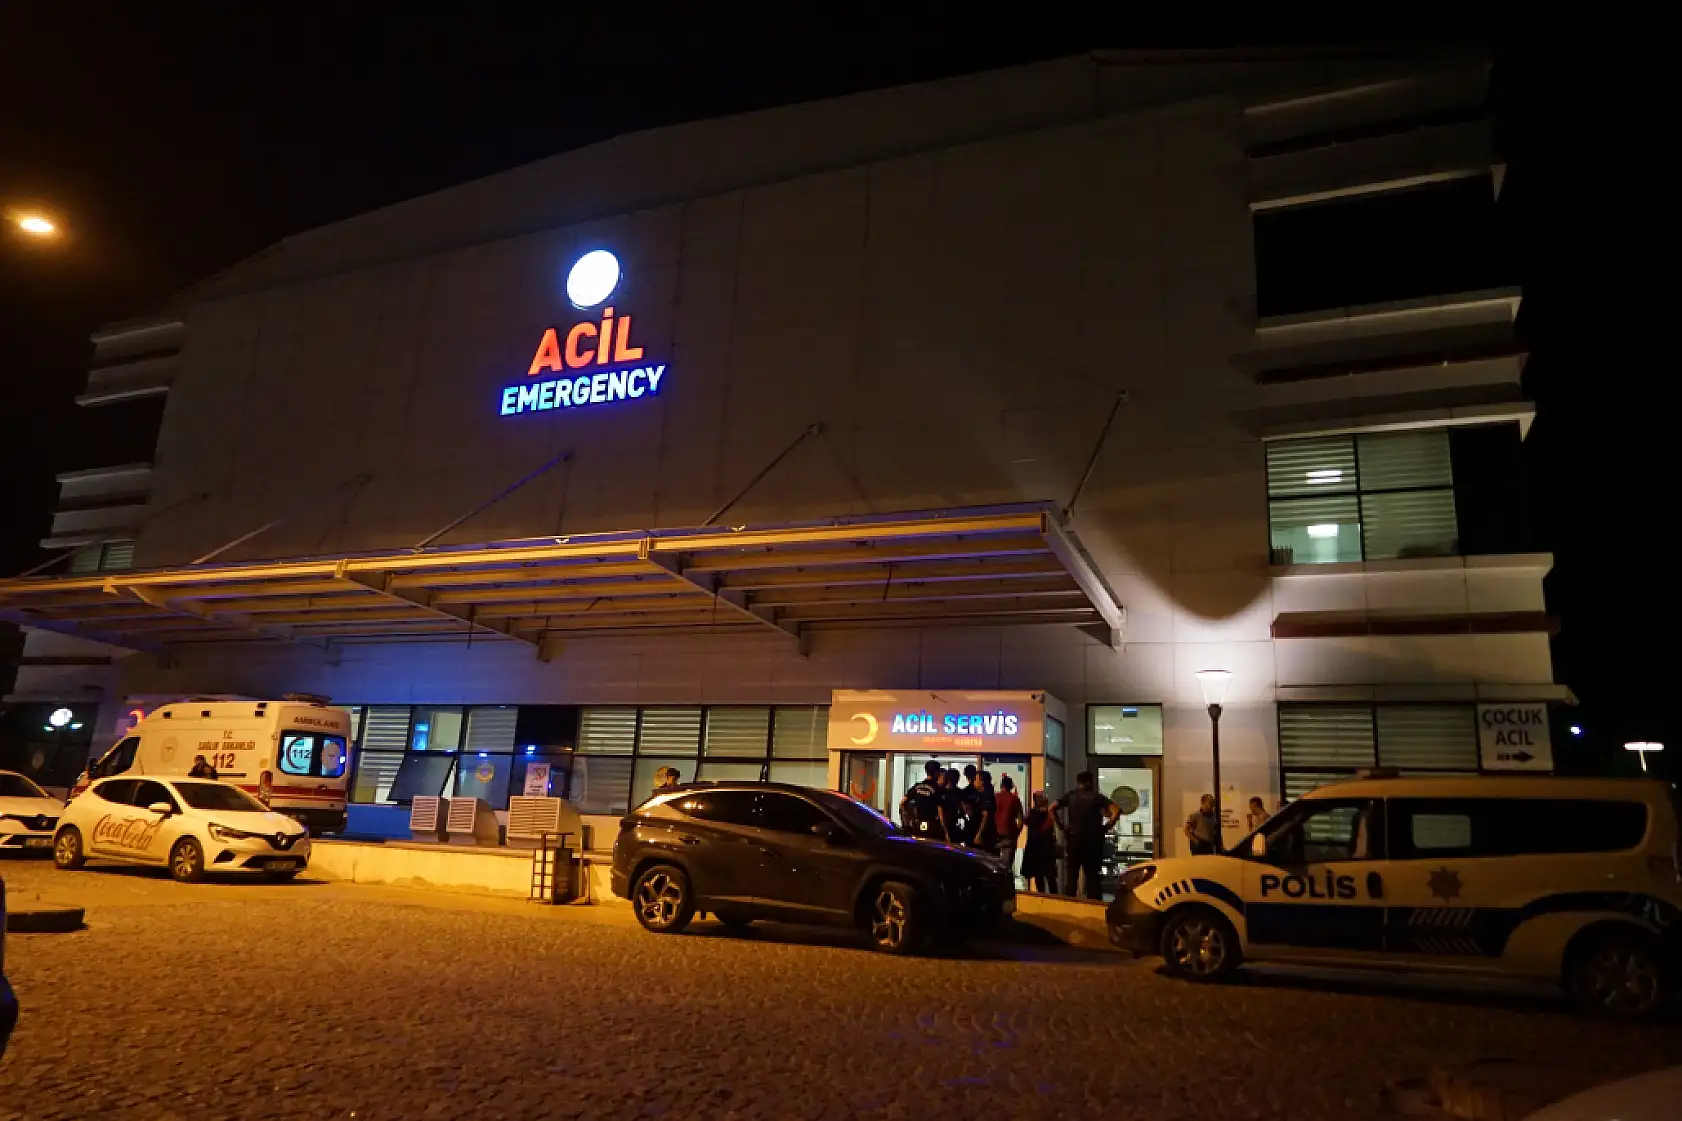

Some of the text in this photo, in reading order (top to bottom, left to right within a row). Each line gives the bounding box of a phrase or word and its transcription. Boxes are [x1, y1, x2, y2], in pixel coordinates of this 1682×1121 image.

[527, 306, 644, 377] ACİL
[500, 364, 666, 416] EMERGENCY
[892, 708, 1018, 735] ACİL SERVİS
[1482, 708, 1543, 729] ÇOCUK
[212, 752, 235, 768] 112
[293, 748, 312, 759] 112
[1261, 868, 1358, 899] POLİS
